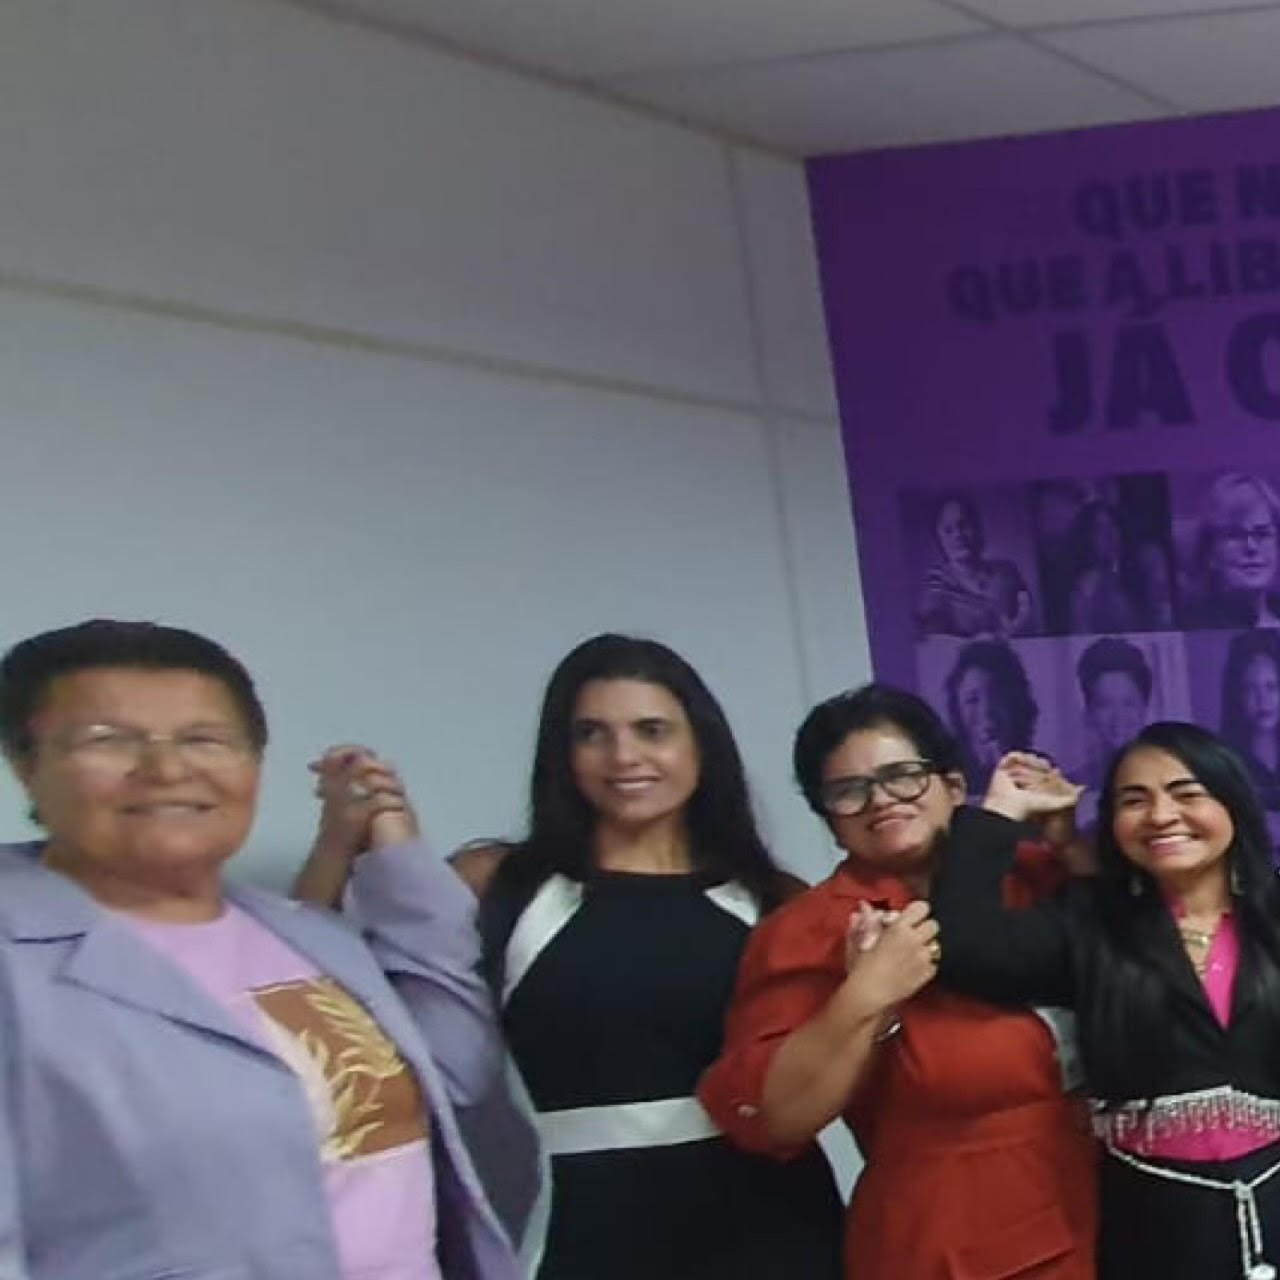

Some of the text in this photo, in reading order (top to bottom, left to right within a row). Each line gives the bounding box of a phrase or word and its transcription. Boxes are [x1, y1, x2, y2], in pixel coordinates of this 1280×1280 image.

[1073, 168, 1217, 240] QUE
[945, 254, 1085, 323] QUE
[1105, 250, 1157, 306] A
[1046, 295, 1197, 437] JÁ
